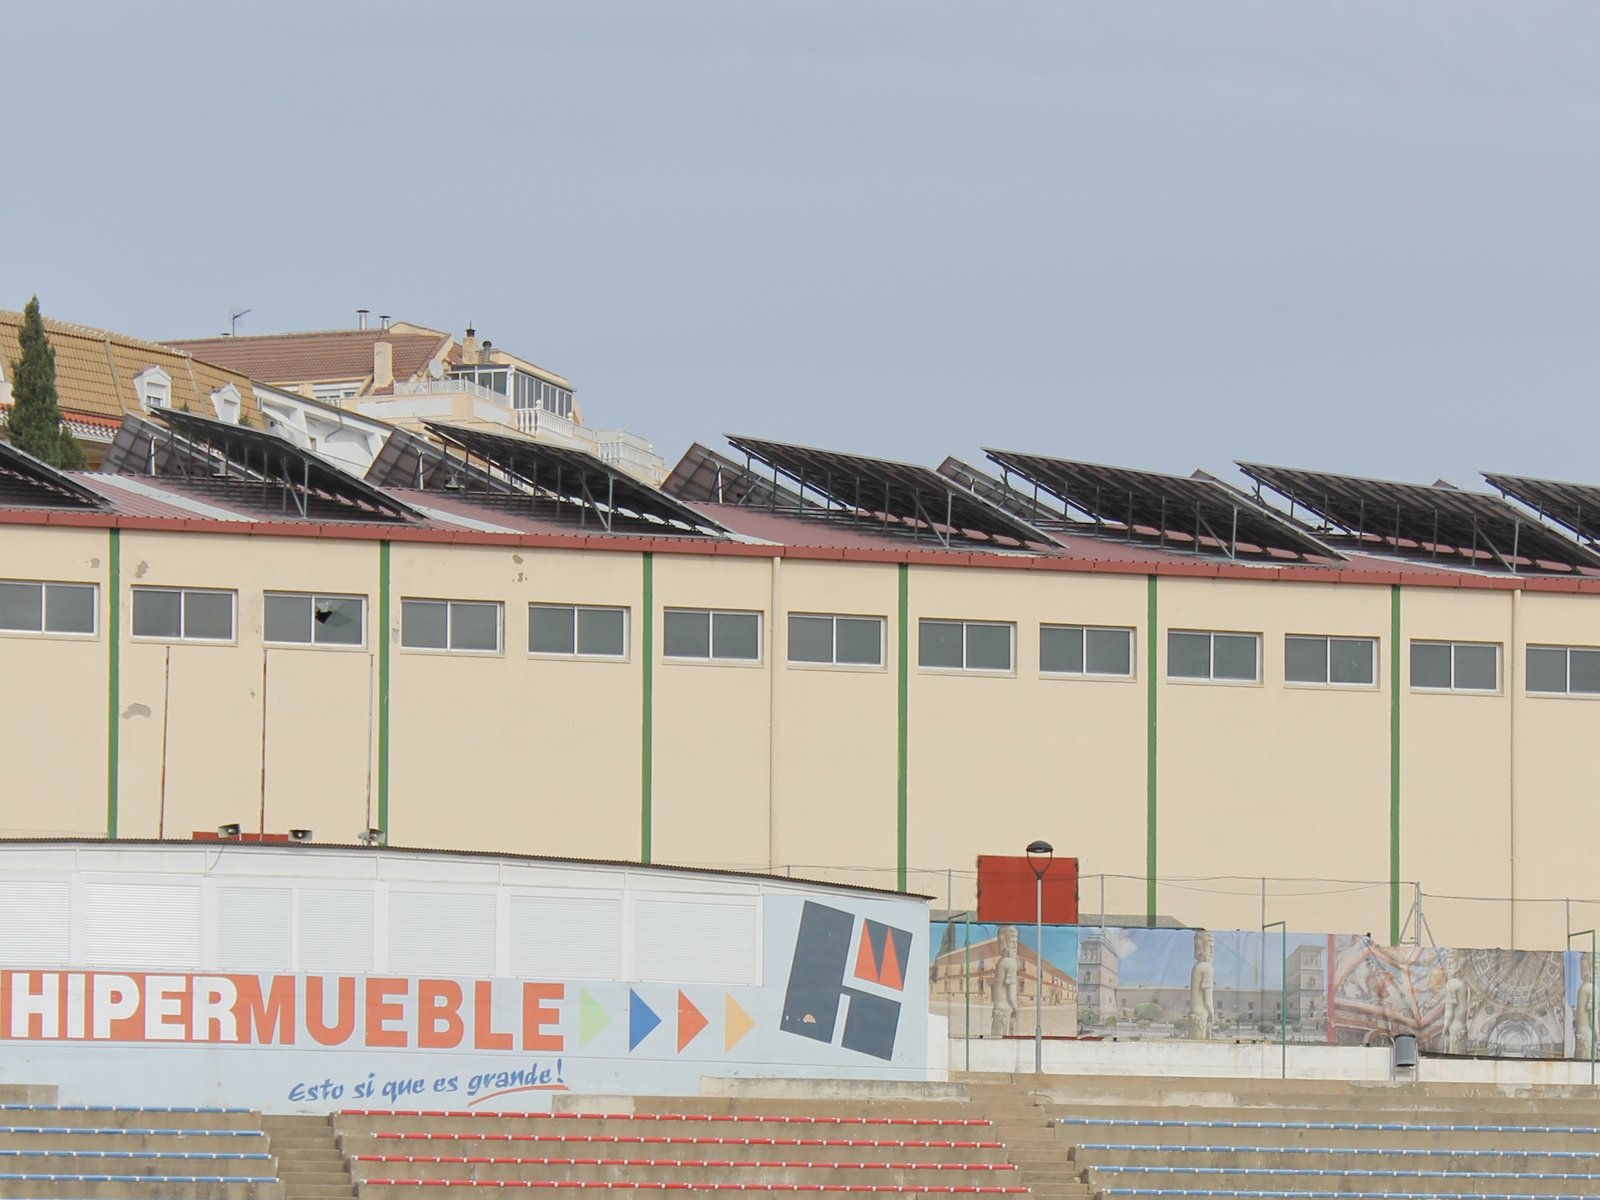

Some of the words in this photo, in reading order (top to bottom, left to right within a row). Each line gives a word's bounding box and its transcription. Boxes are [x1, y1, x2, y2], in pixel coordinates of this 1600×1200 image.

[11, 973, 564, 1051] HIPERMUEBLE
[288, 1079, 344, 1101] Esto
[381, 1076, 425, 1103] que
[433, 1074, 458, 1093] es
[467, 1058, 564, 1096] grande!
